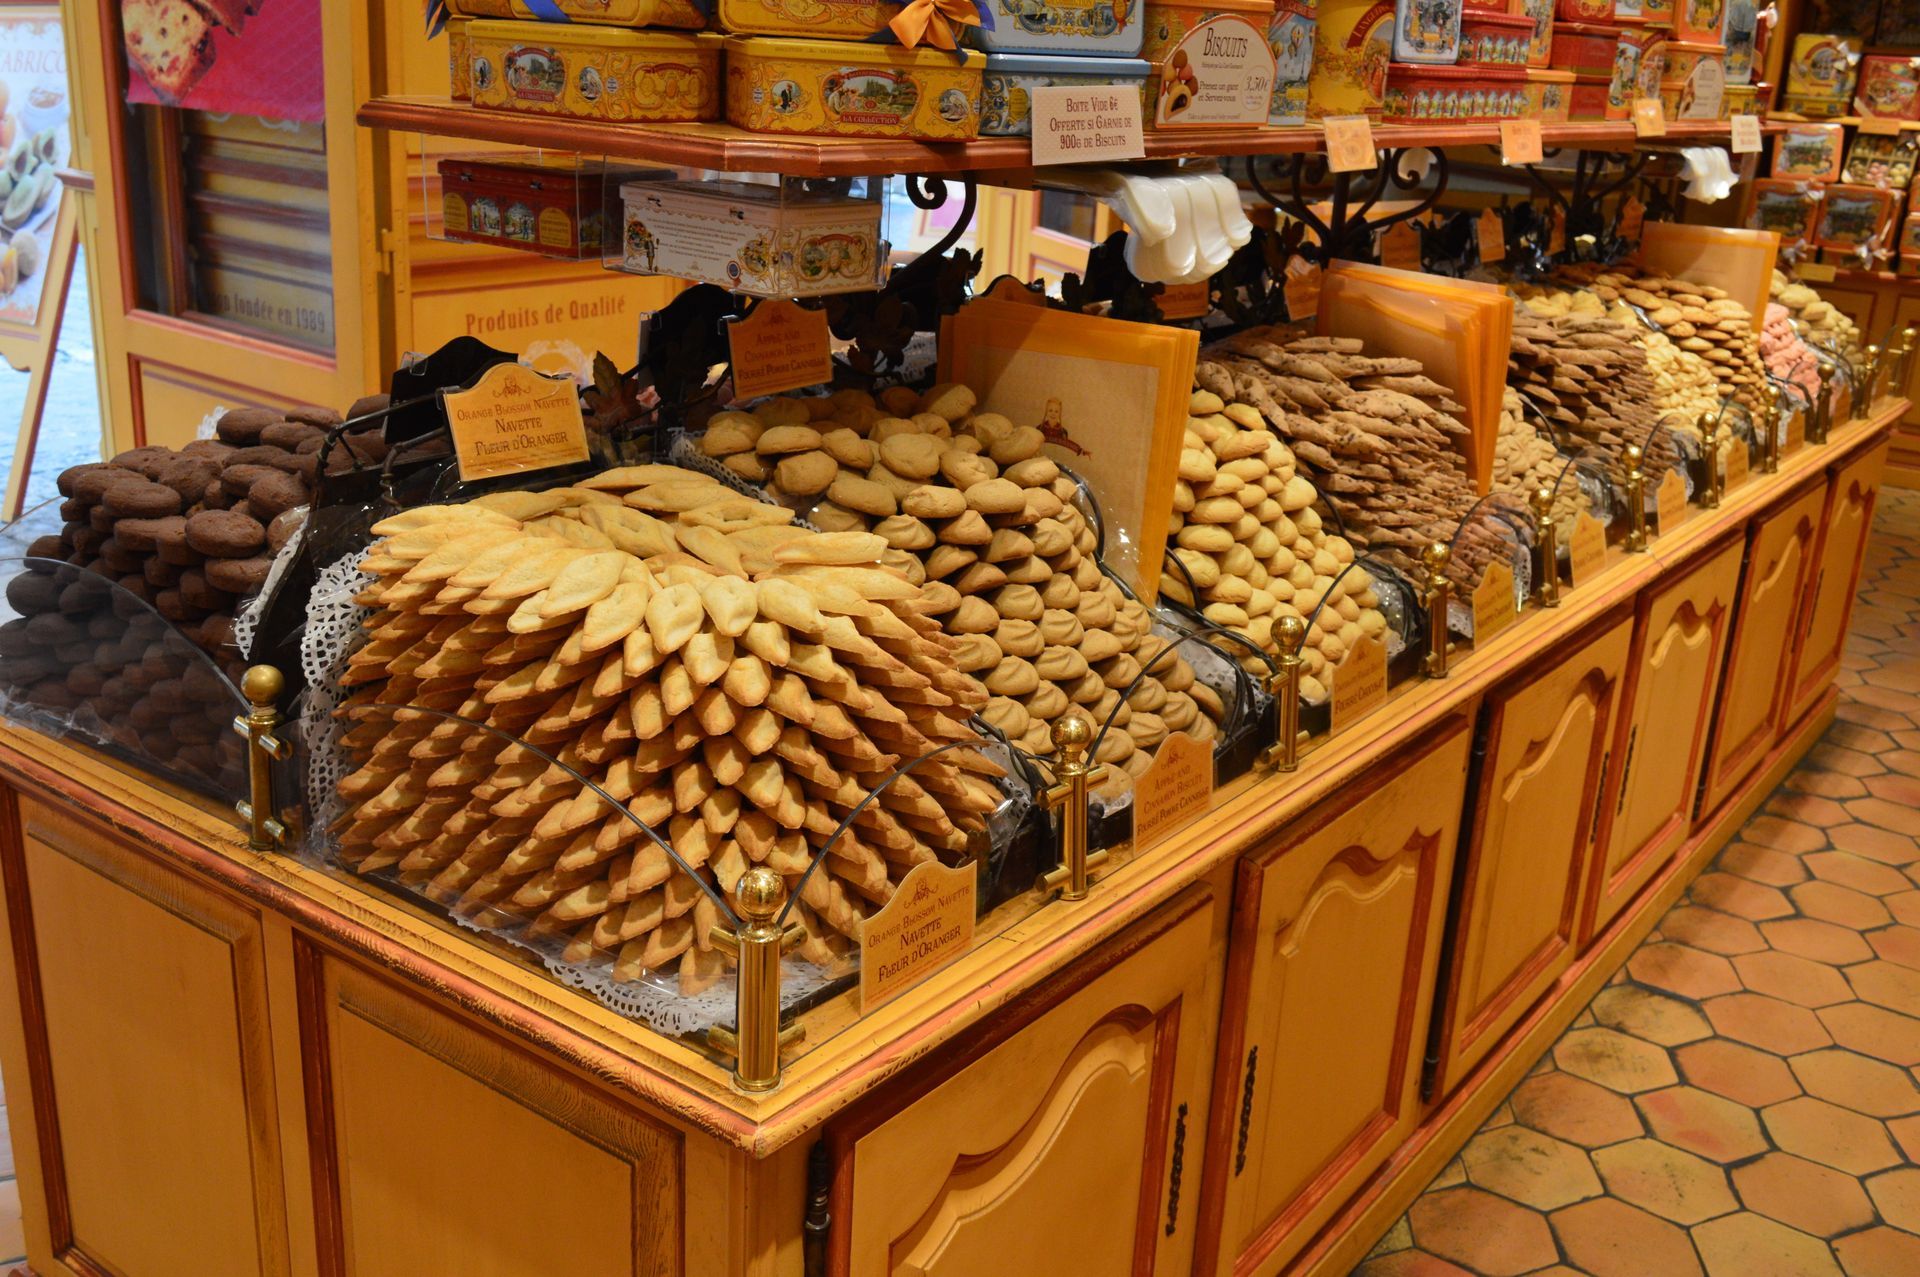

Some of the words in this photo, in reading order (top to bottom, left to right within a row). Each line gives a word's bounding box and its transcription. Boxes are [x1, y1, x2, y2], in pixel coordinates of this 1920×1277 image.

[1203, 27, 1248, 58] BISCUITS
[1066, 98, 1089, 112] BOITE
[1091, 97, 1108, 111] VIDE
[853, 116, 898, 124] COLLECTION
[1050, 117, 1086, 132] OFFERTE
[1096, 115, 1123, 129] GARNIE
[1124, 117, 1132, 128] DE
[1083, 137, 1093, 148] DE
[1095, 133, 1126, 148] BISCUITS
[234, 293, 273, 320] fondée
[277, 306, 292, 325] en
[295, 307, 325, 333] 1989
[466, 307, 539, 335] Produits
[545, 303, 563, 324] de
[570, 295, 625, 320] Qualité
[457, 407, 493, 421] ORANGE
[494, 403, 533, 416] BLOSSOM
[533, 397, 571, 410] NAVETTE
[495, 417, 543, 434] NAVETTE
[475, 440, 510, 456] FLEUR
[868, 924, 900, 948] ORANGE
[902, 905, 935, 928] BLOSSOM
[938, 885, 970, 909] NAVETTE
[900, 917, 942, 950] NAVETTE
[878, 955, 909, 984] FLEUR
